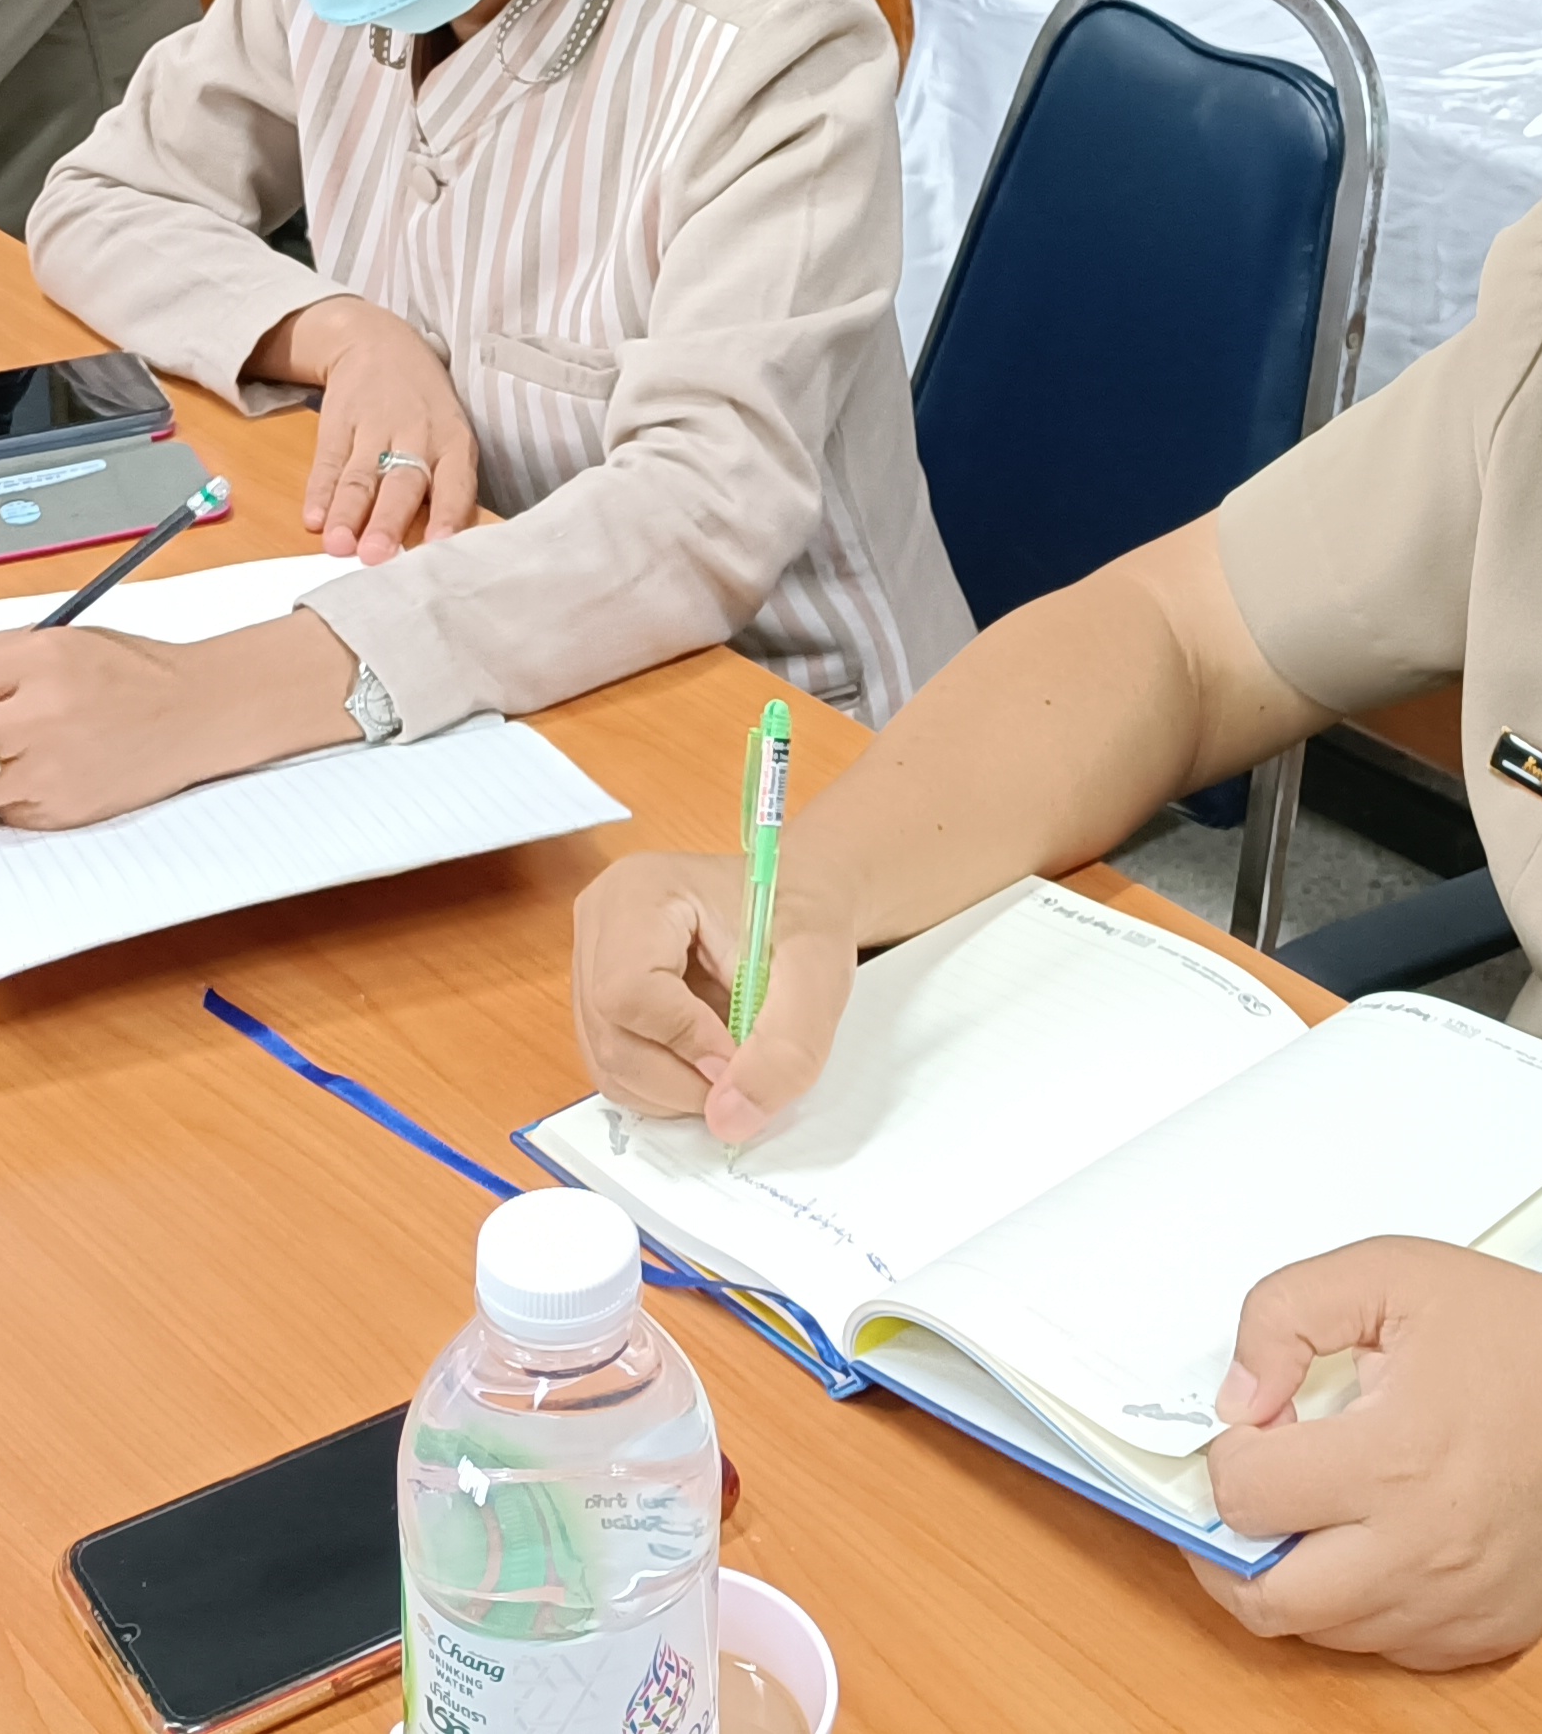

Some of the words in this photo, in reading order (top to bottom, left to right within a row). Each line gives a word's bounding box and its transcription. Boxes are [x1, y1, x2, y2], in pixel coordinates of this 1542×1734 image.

[429, 1648, 483, 1690] DRINKING
[438, 1634, 505, 1682] Chang
[436, 1666, 474, 1698] WATER
